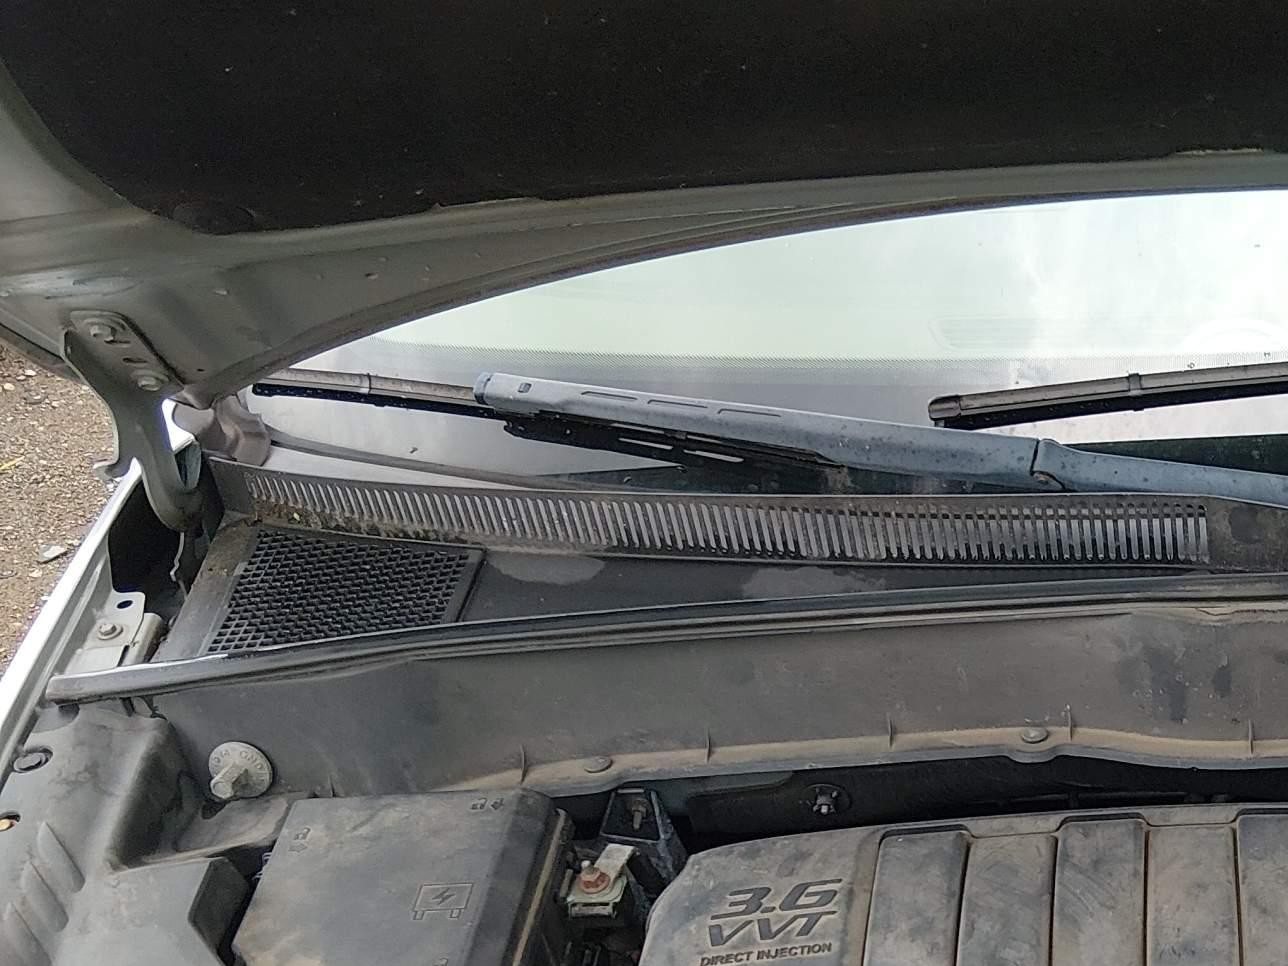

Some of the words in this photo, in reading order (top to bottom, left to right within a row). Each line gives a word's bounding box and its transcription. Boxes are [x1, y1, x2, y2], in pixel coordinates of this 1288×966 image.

[710, 878, 843, 921] 3.6
[708, 910, 838, 947] VVT
[756, 942, 832, 961] INJECTION
